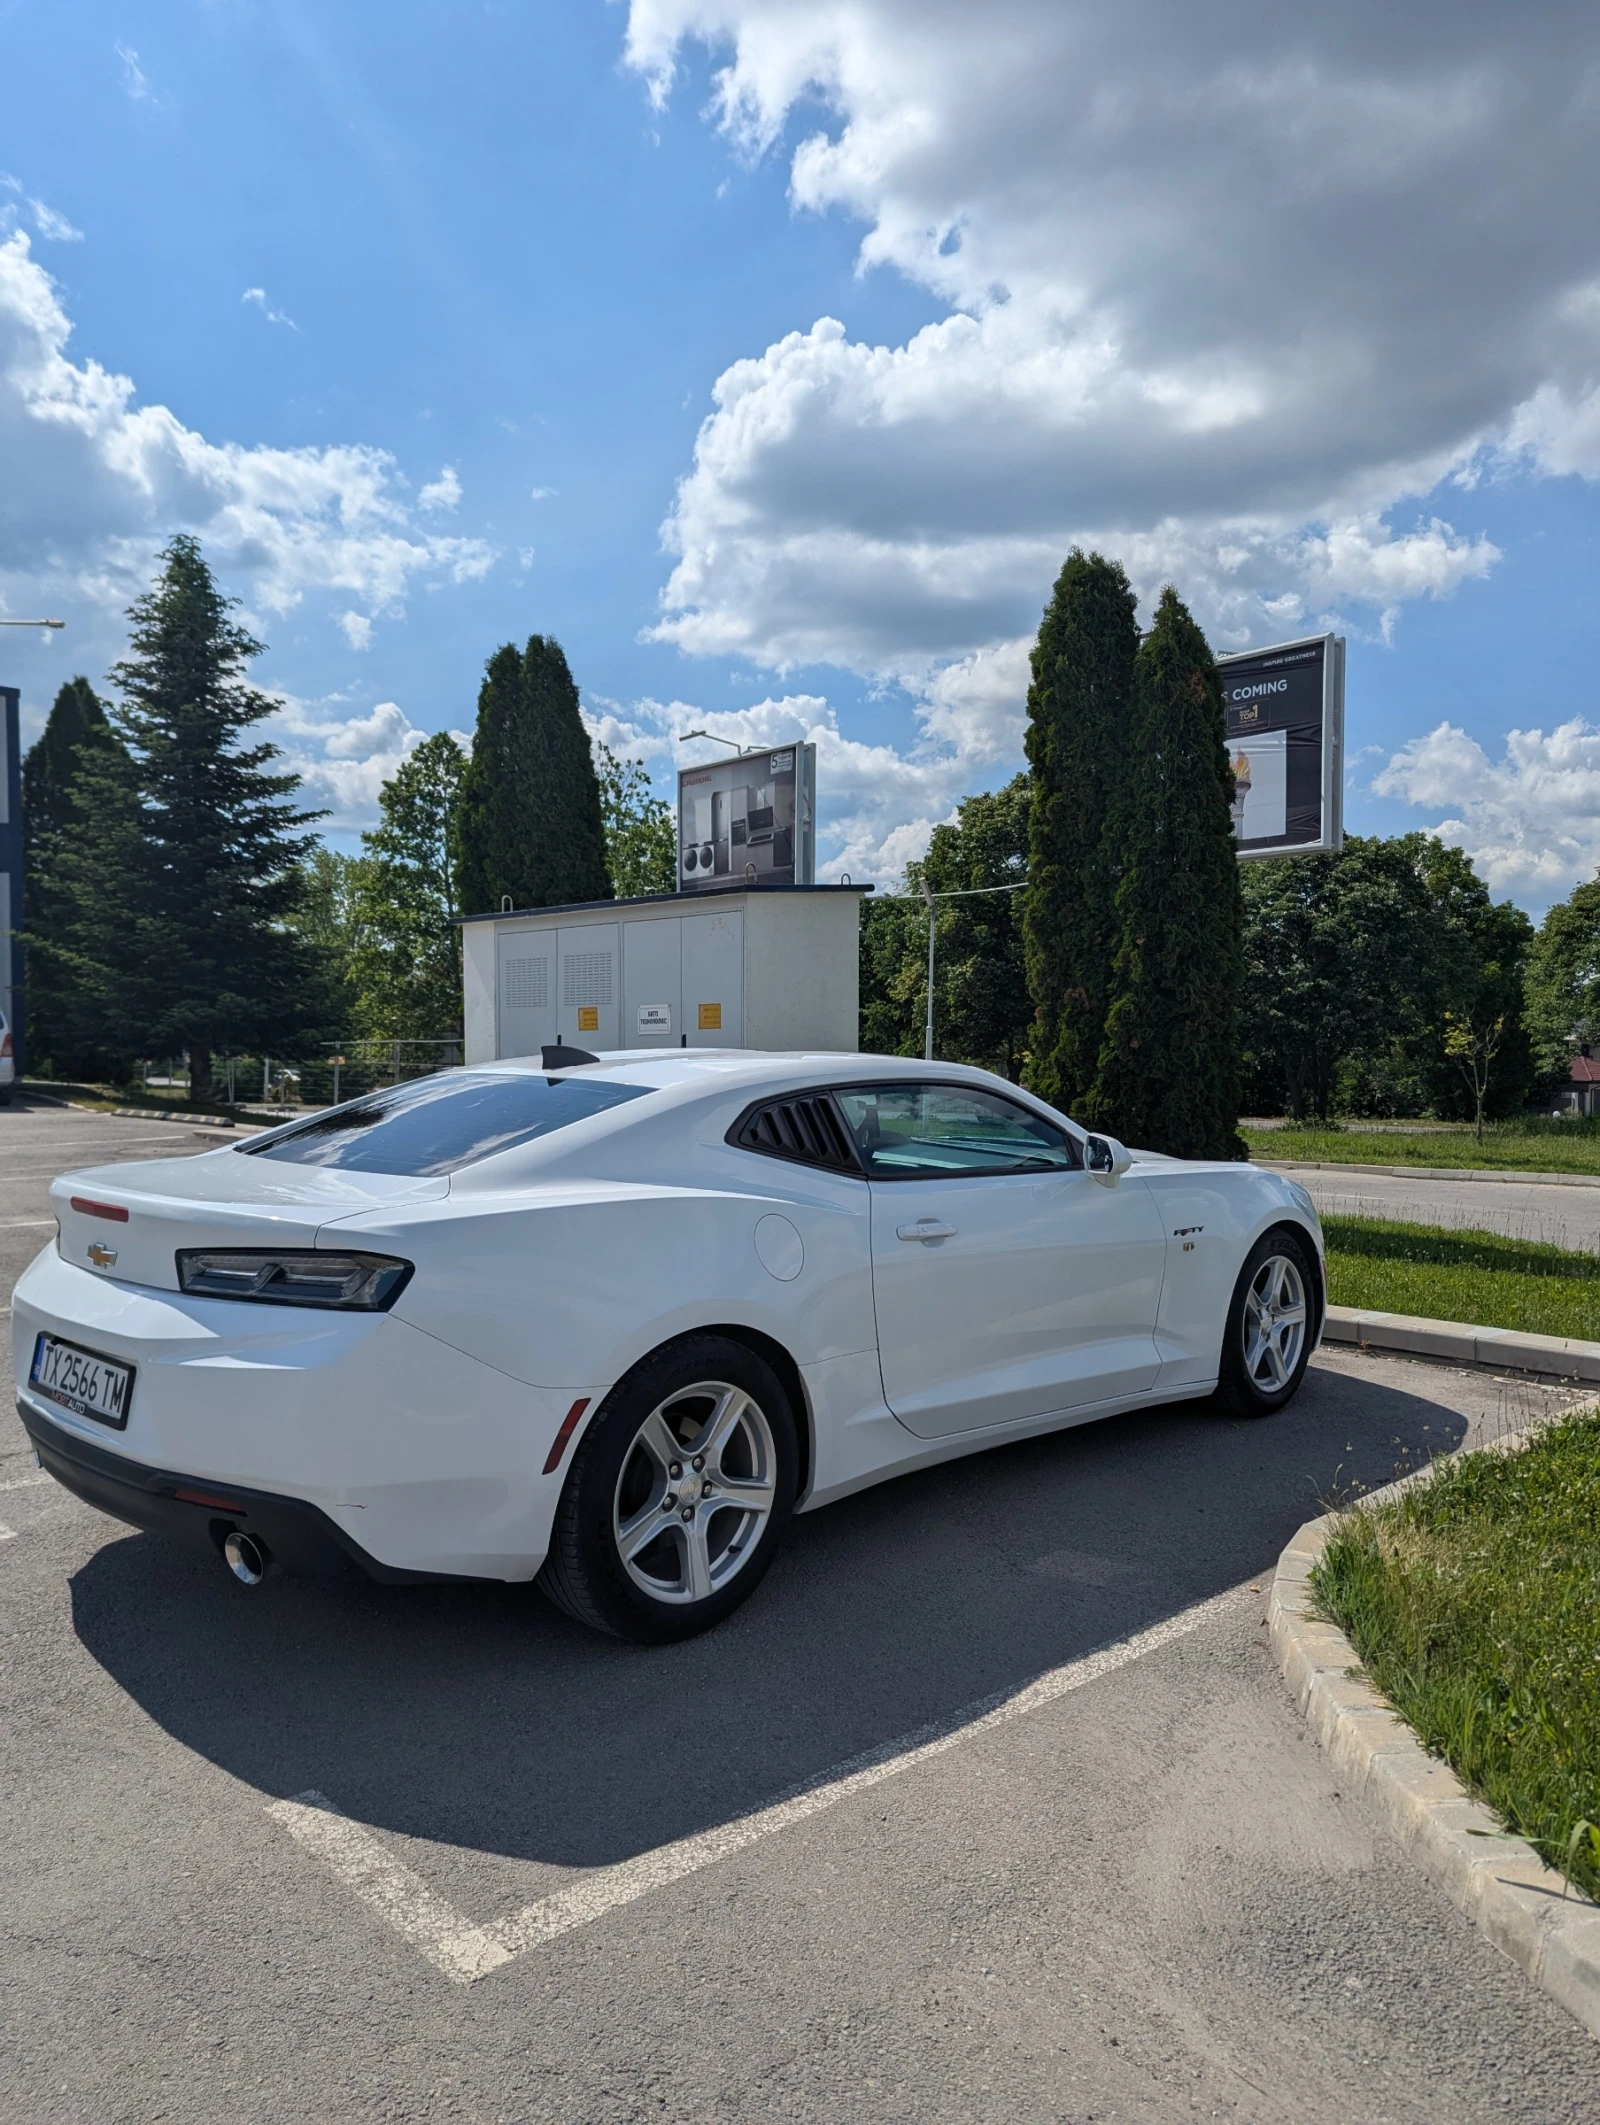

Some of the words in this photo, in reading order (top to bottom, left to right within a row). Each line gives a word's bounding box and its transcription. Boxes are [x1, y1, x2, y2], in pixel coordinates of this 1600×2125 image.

[1262, 658, 1284, 667] INSPIRE
[1284, 651, 1316, 663] GREATNESS
[1232, 679, 1288, 700] COMING
[771, 754, 778, 769] 5
[682, 775, 712, 788] GRUNDIG
[60, 1354, 99, 1402] 2566
[102, 1369, 126, 1413] TM
